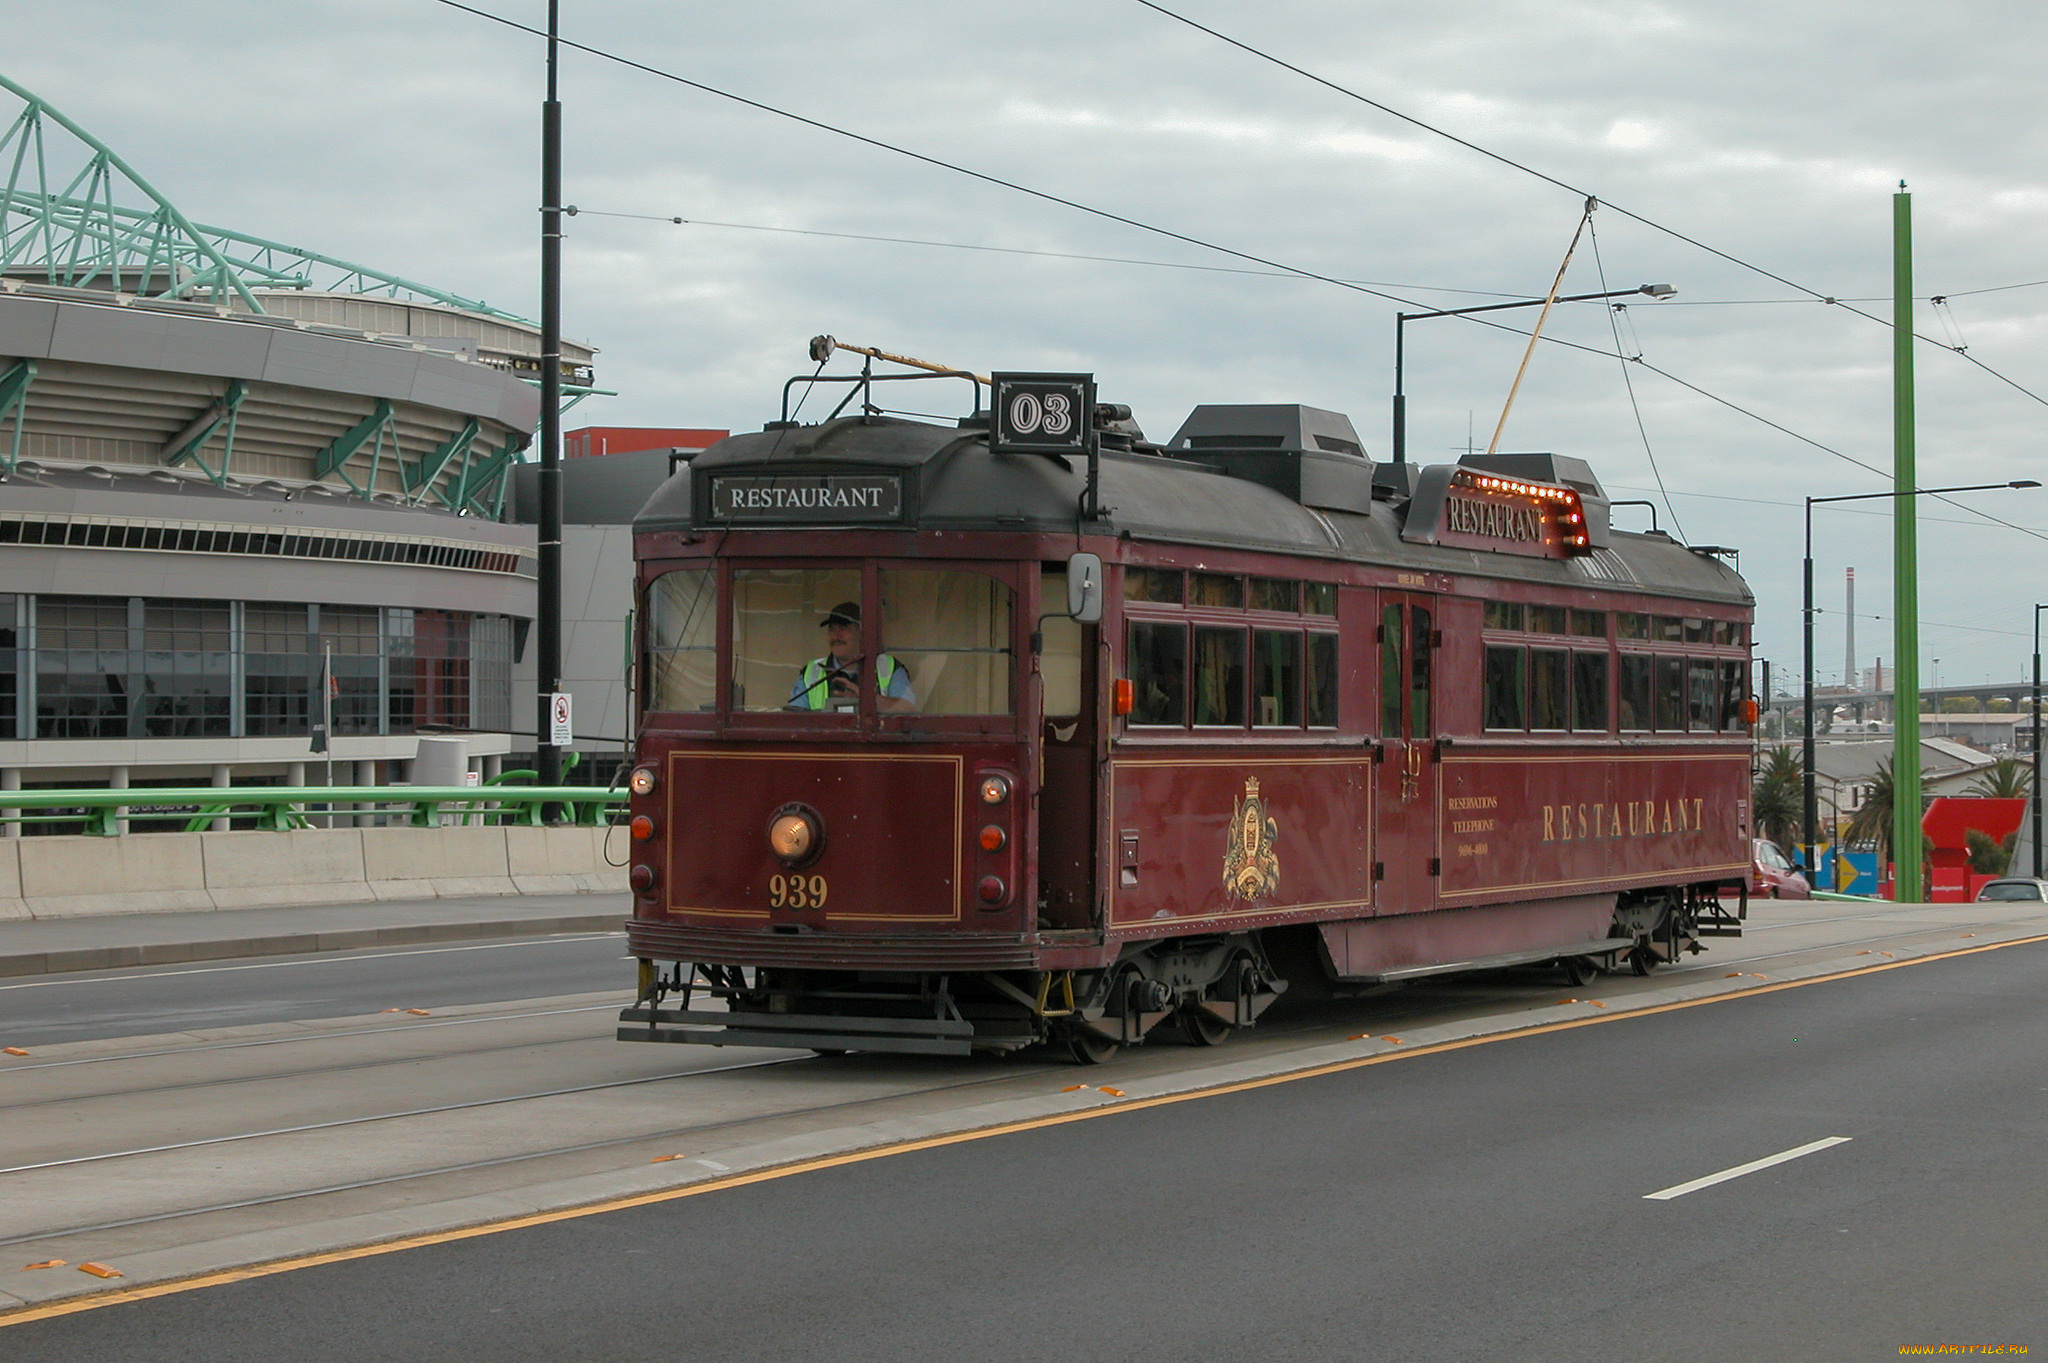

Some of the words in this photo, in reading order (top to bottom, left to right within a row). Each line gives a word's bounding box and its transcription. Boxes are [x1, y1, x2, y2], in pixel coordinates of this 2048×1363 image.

[1010, 393, 1072, 435] 03
[731, 488, 883, 508] RESTAURANT
[1447, 496, 1545, 542] RESTAURANT
[1448, 796, 1498, 810] RESERVATIONS
[1543, 798, 1704, 842] RESTAURANT
[1452, 819, 1495, 833] TELEPHONE
[769, 874, 828, 909] 939
